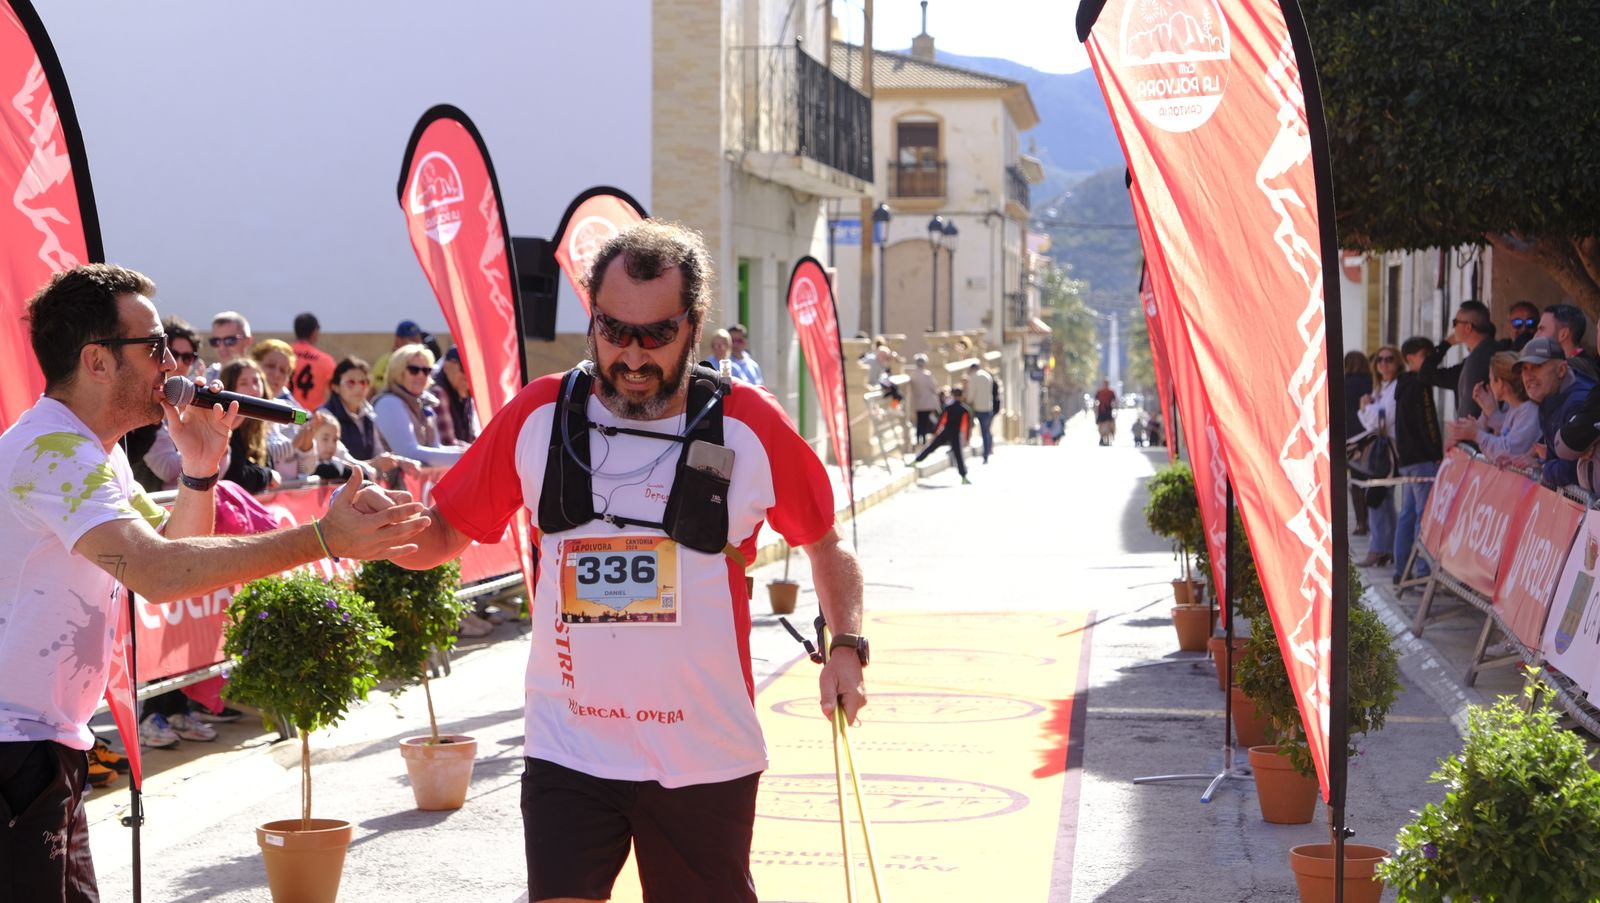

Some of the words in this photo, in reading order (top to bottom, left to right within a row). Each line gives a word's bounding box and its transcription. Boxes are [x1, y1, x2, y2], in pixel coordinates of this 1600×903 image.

[581, 543, 612, 552] POLVORA
[577, 555, 656, 585] 336
[636, 708, 684, 725] OVERA
